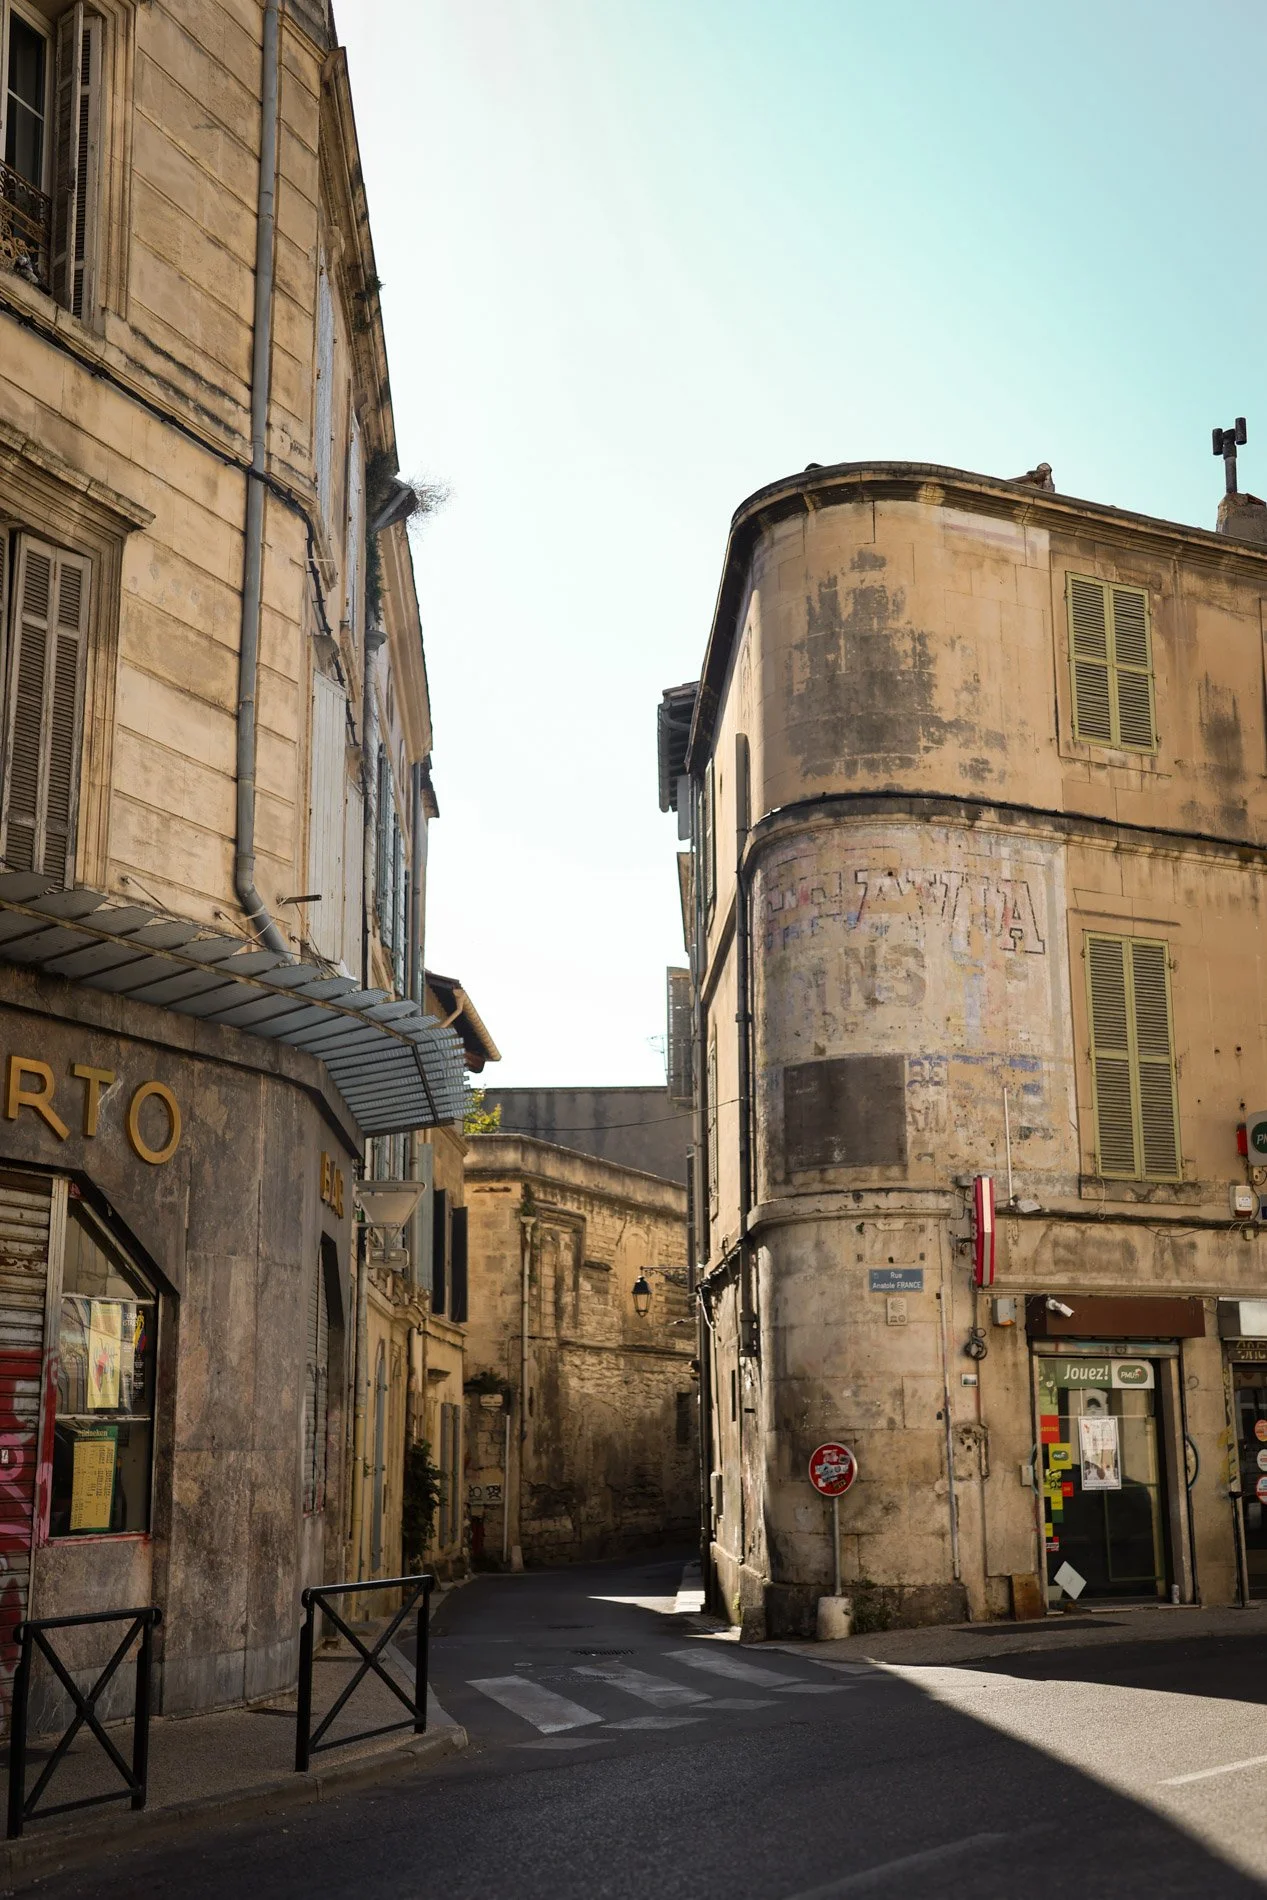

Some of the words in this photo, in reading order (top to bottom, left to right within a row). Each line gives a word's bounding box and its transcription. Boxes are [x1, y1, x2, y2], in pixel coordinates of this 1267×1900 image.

[7, 1055, 182, 1165] RTO
[320, 1150, 344, 1219] BAR
[890, 1271, 903, 1279] Rue
[896, 1281, 922, 1289] FRANCE
[1063, 1364, 1108, 1380] Jouez!
[1120, 1371, 1135, 1379] PMU
